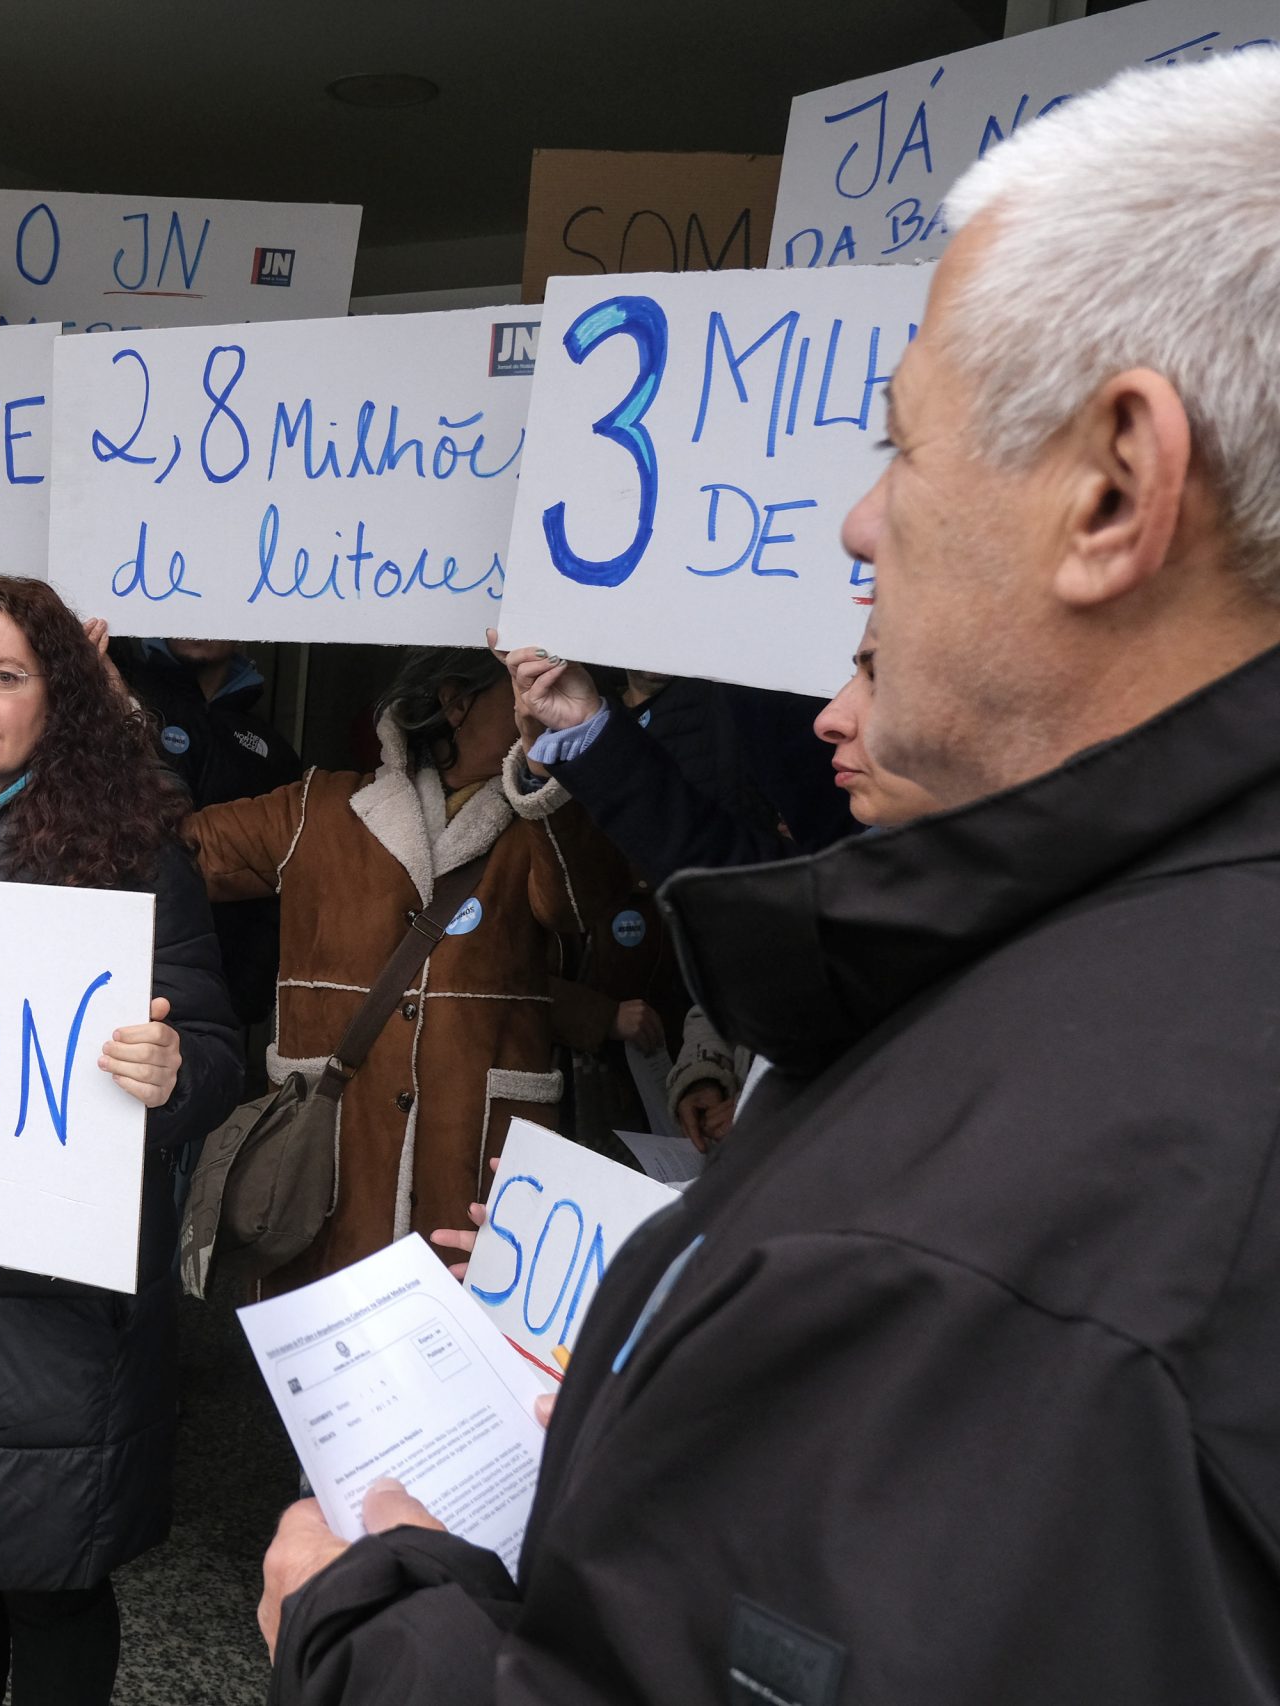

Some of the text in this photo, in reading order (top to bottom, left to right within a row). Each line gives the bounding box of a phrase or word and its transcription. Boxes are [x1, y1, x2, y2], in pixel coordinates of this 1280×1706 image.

[825, 66, 945, 199] JÁ
[16, 203, 210, 290] O JN
[262, 252, 291, 276] JN
[563, 206, 751, 274] SOM
[881, 197, 948, 254] BA
[498, 327, 540, 361] JN
[92, 344, 526, 484] 2,8 Milhõe
[542, 294, 918, 588] 3 MILH
[112, 503, 506, 603] de leitores
[685, 483, 818, 578] DE
[234, 730, 258, 748] NORTH
